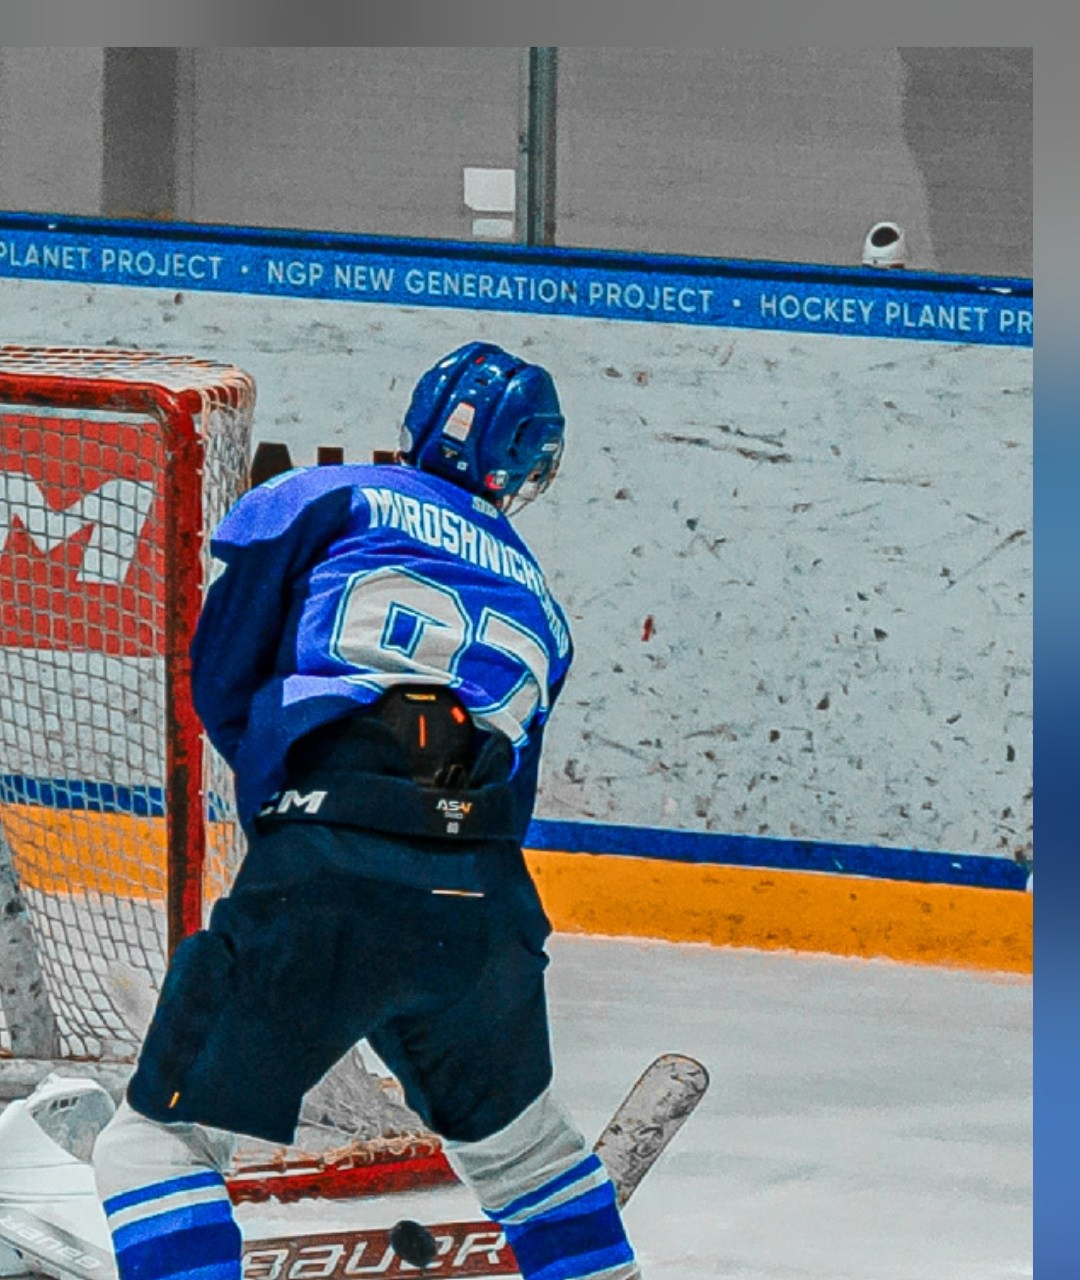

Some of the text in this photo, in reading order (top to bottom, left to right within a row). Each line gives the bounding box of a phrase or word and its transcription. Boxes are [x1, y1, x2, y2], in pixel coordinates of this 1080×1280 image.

[101, 248, 222, 280] PROJECT
[267, 260, 323, 287] NGP
[333, 264, 395, 291] NEW
[405, 269, 578, 304] GENERATION
[588, 281, 713, 313] PROJECT
[759, 293, 874, 324] HOCKEY
[884, 301, 988, 332] PLANET
[361, 486, 570, 659] MIROSHNICH
